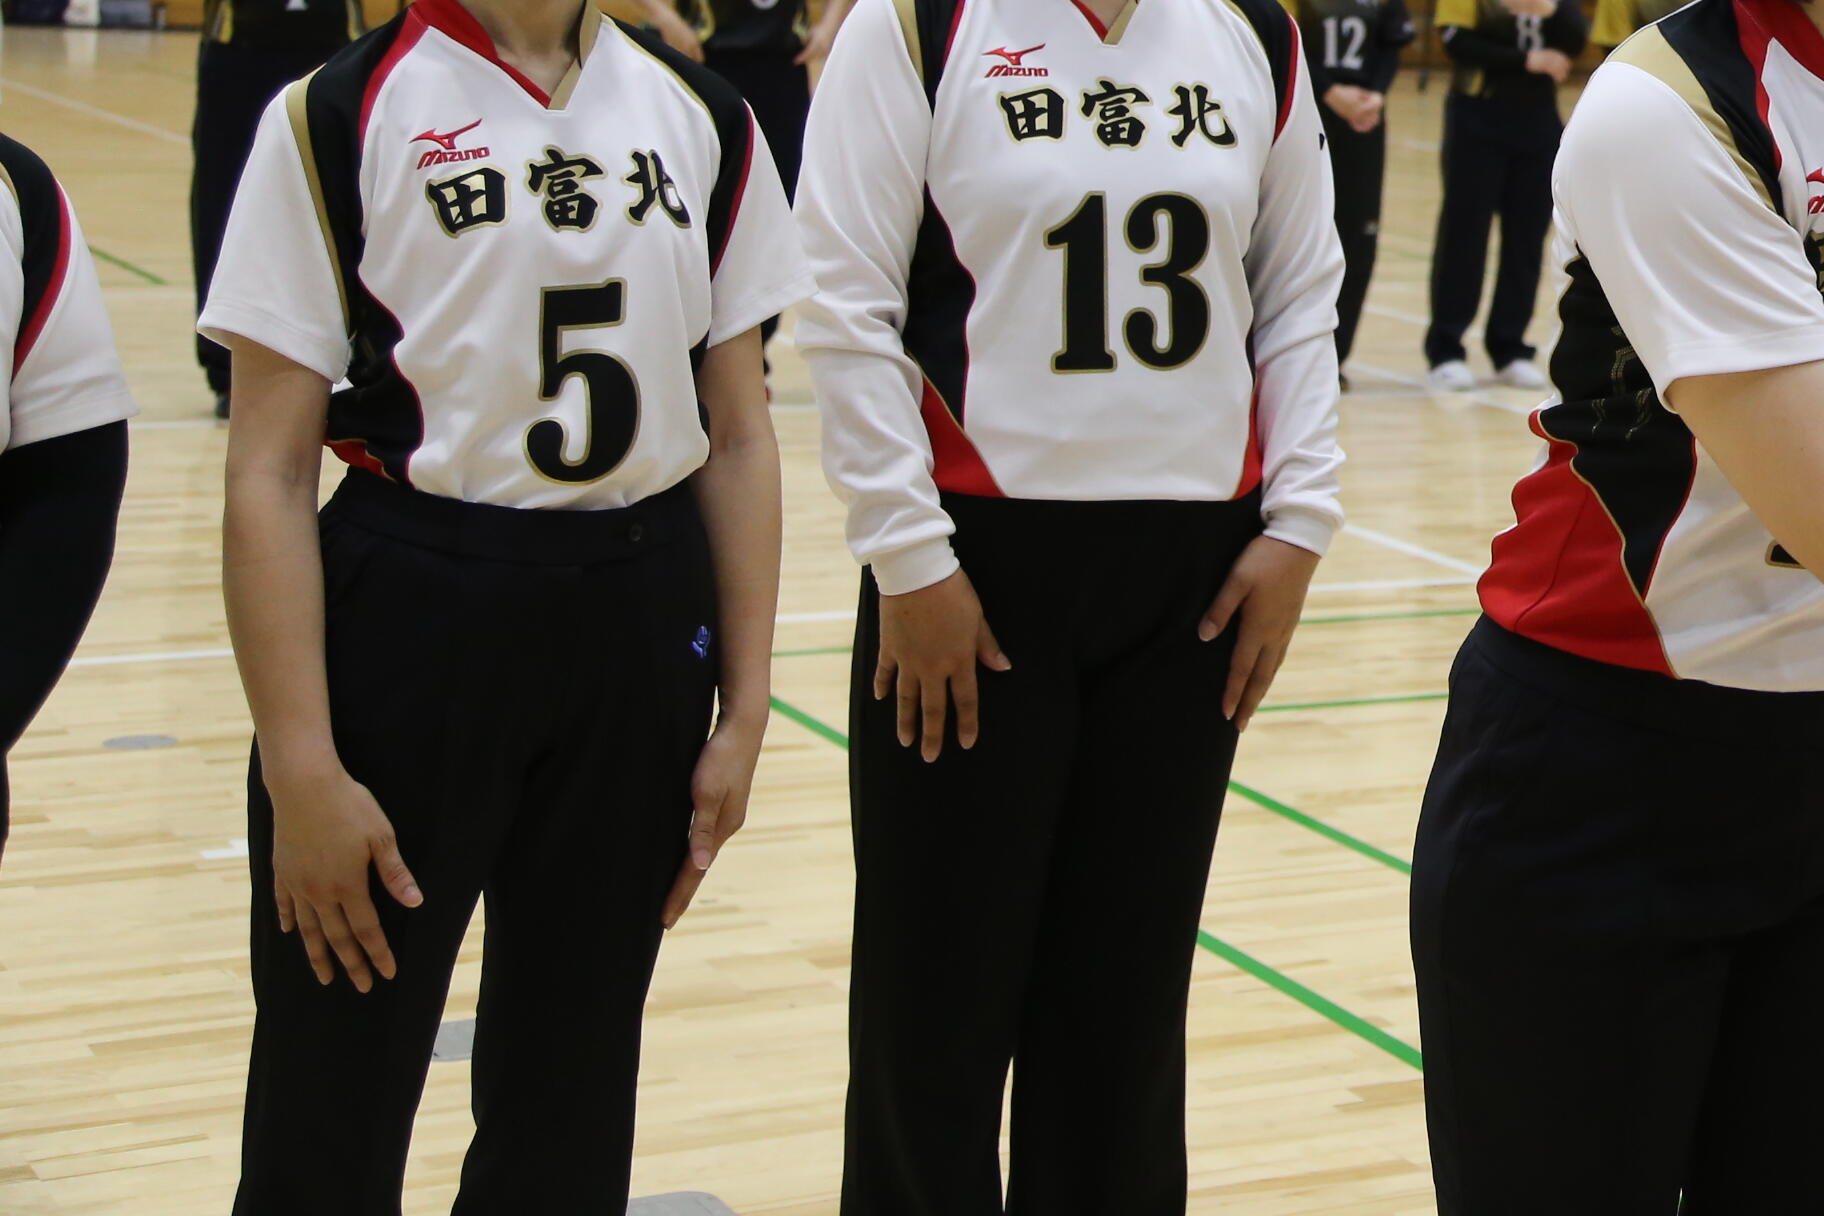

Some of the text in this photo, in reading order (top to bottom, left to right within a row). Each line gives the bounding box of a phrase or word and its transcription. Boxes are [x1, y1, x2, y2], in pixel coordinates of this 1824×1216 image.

[984, 64, 1049, 79] MIZUNO
[1323, 16, 1366, 70] 12
[997, 76, 1239, 152] 田富北
[416, 145, 491, 171] MIZUNO
[424, 144, 693, 239] 田富北
[1042, 190, 1212, 375] 13
[522, 276, 642, 487] 5
